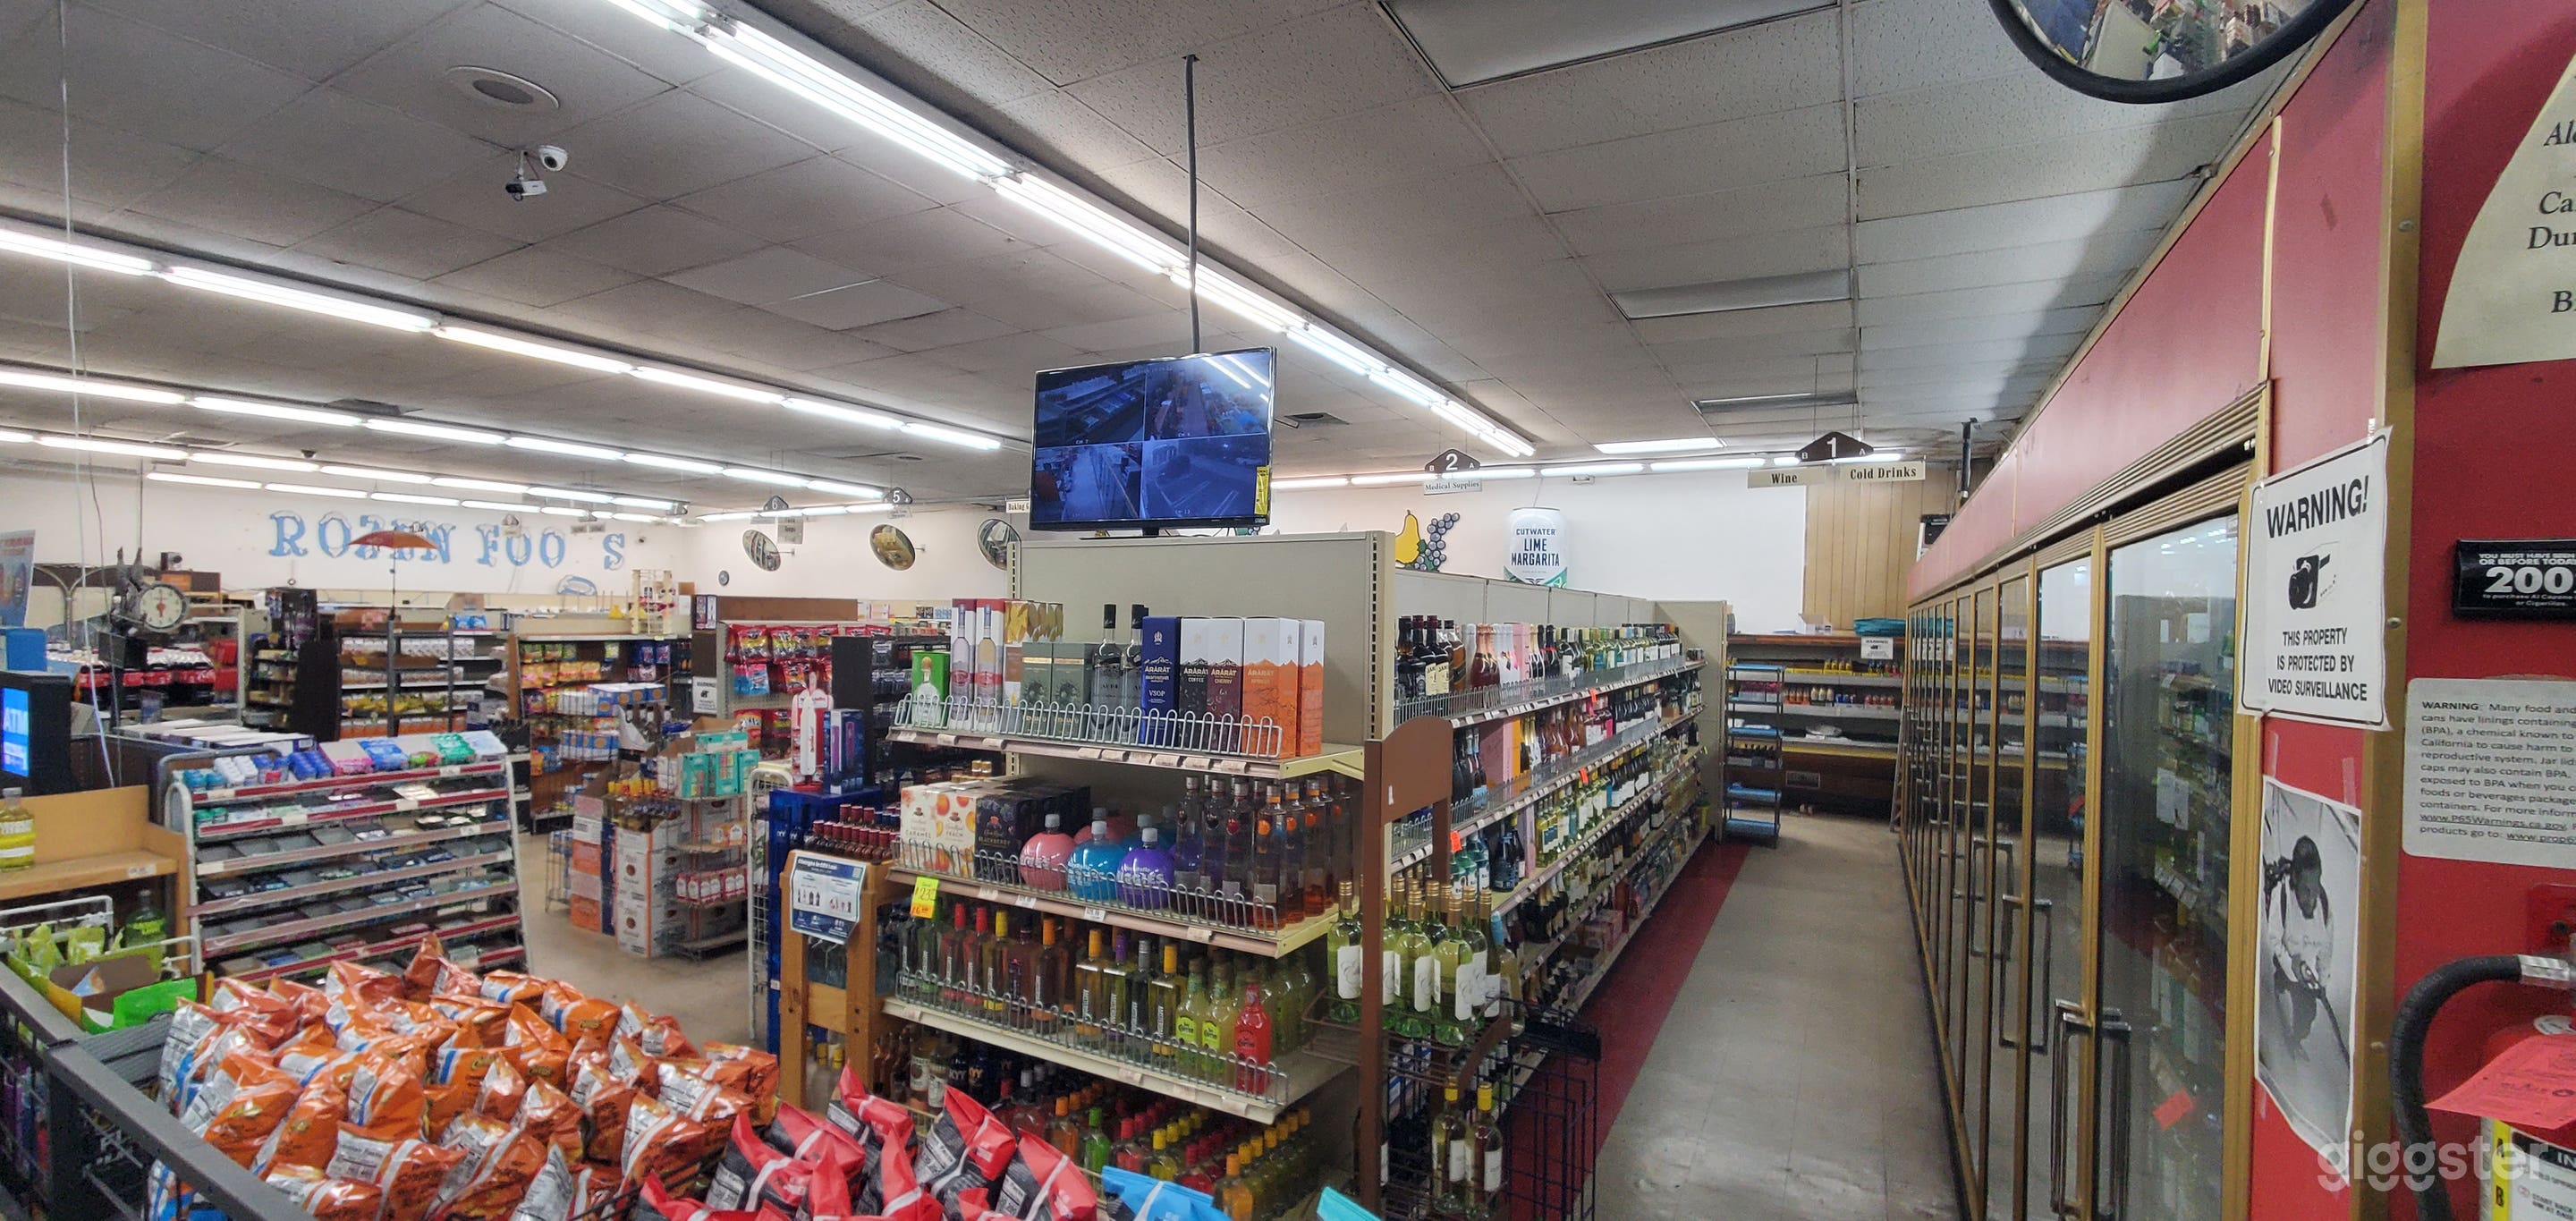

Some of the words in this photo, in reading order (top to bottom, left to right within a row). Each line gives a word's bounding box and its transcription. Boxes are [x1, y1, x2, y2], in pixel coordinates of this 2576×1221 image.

[1826, 437, 1837, 458] 1
[1445, 453, 1459, 471] 2
[1801, 452, 1809, 460] B
[1771, 472, 1798, 484] Wine
[1850, 469, 1874, 480] Cold
[1877, 466, 1917, 479] Drinks
[1424, 482, 1451, 491] Medical
[1452, 480, 1479, 489] Supplies
[893, 490, 901, 504] 5
[2267, 475, 2369, 538] WARNING!
[1516, 528, 1556, 536] CUTWATER
[1524, 538, 1547, 552] LIME
[1511, 552, 1560, 566] MARGARITA
[2484, 566, 2576, 594] 200
[2282, 630, 2301, 647] THIS
[2302, 627, 2348, 646] PROPERTY
[2276, 655, 2285, 671] IS
[2287, 655, 2336, 672] PROTECTED
[2340, 655, 2355, 673] BY
[2267, 678, 2292, 696] VIDEO
[2294, 680, 2368, 701] SURVEILLANCE
[2489, 703, 2521, 713] Many
[2525, 704, 2551, 713] food
[2555, 705, 2576, 714] and
[2421, 715, 2445, 723] cans
[2449, 715, 2475, 724] have
[2478, 716, 2514, 726] linings
[2420, 725, 2453, 736] (BPA),
[2466, 726, 2516, 737] chemical
[2519, 730, 2558, 739] known
[2562, 732, 2574, 740] to
[2420, 738, 2473, 748] California
[2476, 741, 2488, 750] to
[2491, 742, 2523, 751] cause
[2526, 743, 2557, 752] harm
[2560, 745, 2573, 753] to
[2420, 750, 2491, 761] reproductive
[2494, 755, 2538, 765] system.
[2540, 757, 2556, 766] Jar
[2420, 763, 2445, 773] caps
[2448, 766, 2470, 775] may
[2473, 767, 2496, 776] also
[2499, 767, 2542, 776] contain
[2546, 769, 2572, 779] BPA.
[2419, 776, 2466, 786] exposed
[2469, 778, 2481, 786] to
[2484, 779, 2505, 788] BPA
[2508, 781, 2540, 790] when
[2543, 783, 2565, 792] you
[2420, 788, 2451, 797] foods
[2453, 790, 2465, 798] or
[2468, 791, 2526, 803] beverages
[2419, 801, 2481, 811] containers.
[2484, 804, 2503, 813] For
[2505, 807, 2537, 816] more
[2419, 826, 2468, 836] products
[2470, 830, 2485, 839] go
[2496, 1184, 2504, 1208] B
